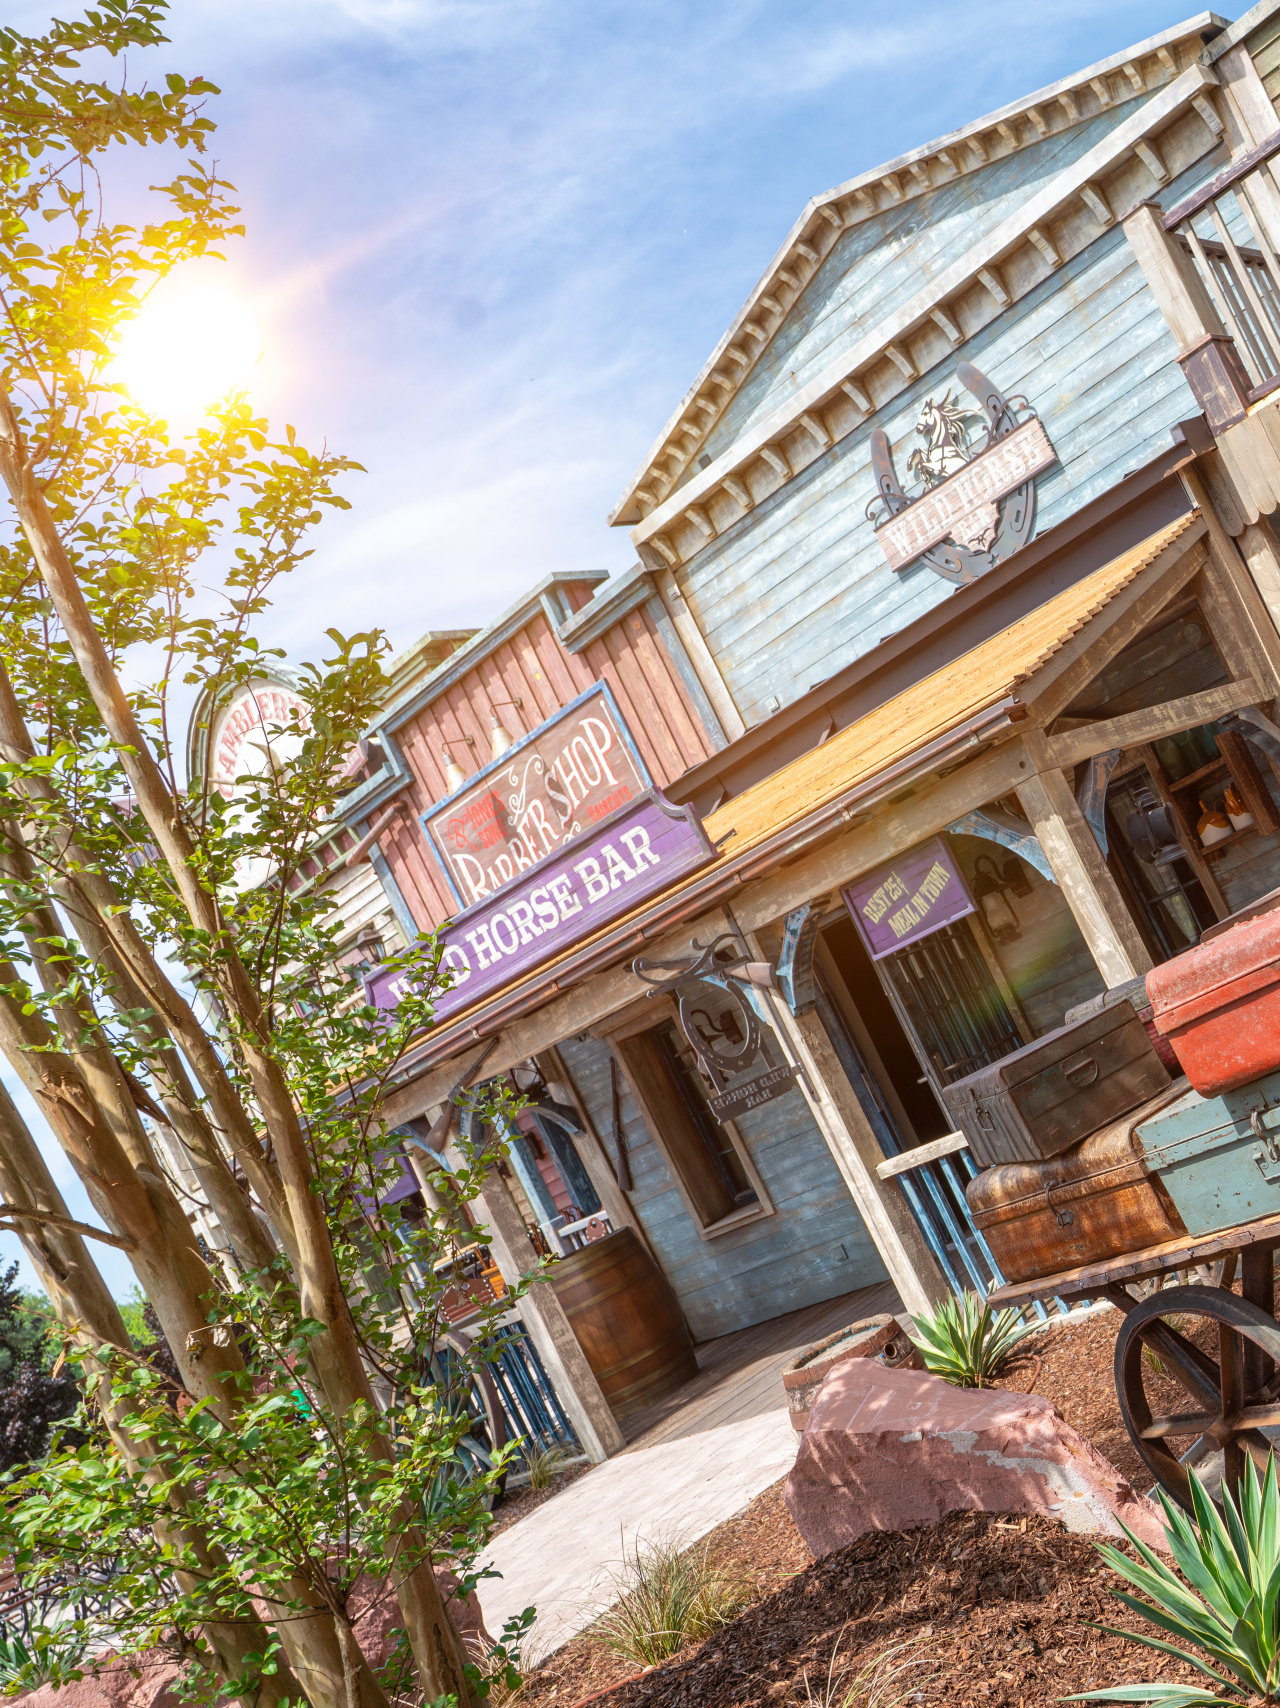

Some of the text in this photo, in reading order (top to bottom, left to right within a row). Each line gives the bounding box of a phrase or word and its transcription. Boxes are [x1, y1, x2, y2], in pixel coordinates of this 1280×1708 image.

[885, 430, 1044, 557] WILD HORSE
[957, 507, 992, 540] BAR
[544, 718, 619, 830] SHOP
[465, 789, 505, 831] JONES
[586, 785, 633, 822] HAIRCUTS
[447, 814, 507, 852] & SONS
[465, 873, 583, 970] HORSE
[573, 825, 661, 904] BAR
[862, 887, 892, 924] BEST
[888, 861, 951, 938] MEAL IN TOWN
